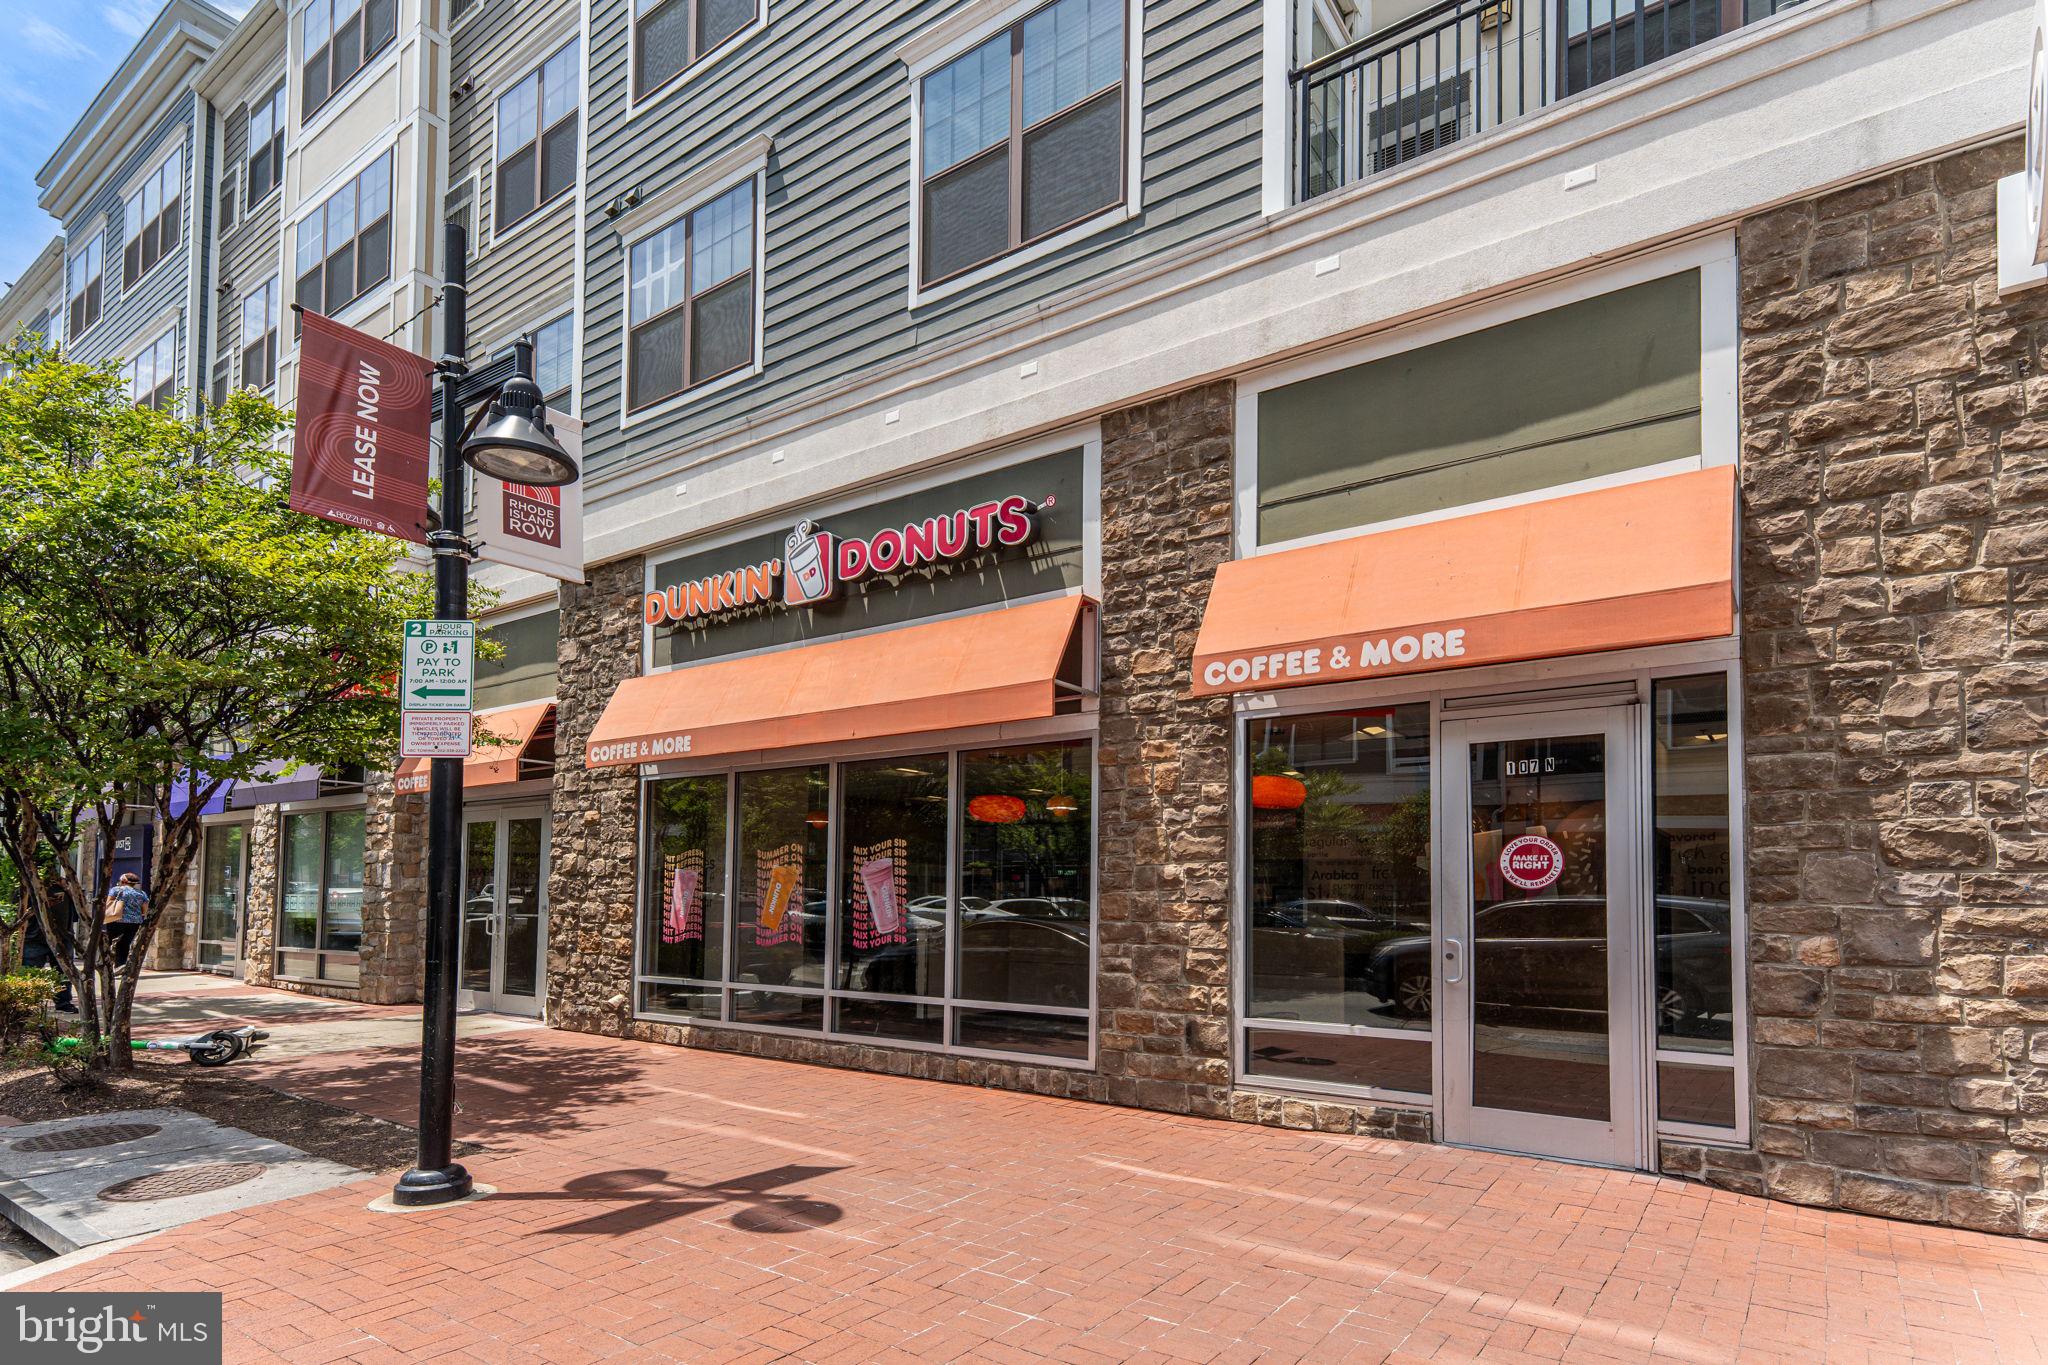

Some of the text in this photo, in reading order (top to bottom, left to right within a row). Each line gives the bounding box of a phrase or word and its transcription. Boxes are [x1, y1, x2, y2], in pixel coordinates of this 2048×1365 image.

[352, 360, 380, 500] LEASE NOW
[510, 498, 554, 519] RHODE
[336, 511, 372, 526] BOZZUTO
[510, 508, 554, 528] ISLAND
[510, 518, 554, 540] ROW
[645, 558, 782, 626] DUNKIN'
[838, 495, 1032, 581] DONUTS
[411, 623, 422, 636] 2
[416, 658, 460, 666] PAY TO
[1204, 629, 1466, 686] COFFEE & MORE
[422, 668, 454, 676] PARK
[590, 736, 692, 762] COFFEE & MORE
[1507, 758, 1554, 775] 107 N
[398, 775, 428, 791] COFFEE
[1669, 832, 1716, 842] avored
[756, 844, 802, 860] SUMMER ON
[853, 838, 907, 856] MIX YOUR SIP
[894, 848, 907, 857] SIP
[1504, 842, 1518, 856] LOVE
[1540, 840, 1558, 856] ORDER
[664, 849, 704, 862] HIT REFRESH
[756, 854, 802, 869] SUMMER ON
[664, 862, 676, 871] HIT
[894, 857, 907, 867] SIP
[1512, 862, 1550, 870] RIGHT
[664, 870, 675, 880] HIT
[894, 867, 907, 876] SIP
[1312, 870, 1358, 880] Arabica
[1688, 865, 1724, 874] bean
[664, 878, 674, 888] HIT
[894, 876, 907, 886] SIP
[1530, 872, 1556, 886] REMAKE
[853, 892, 868, 901] MIX
[853, 902, 868, 911] MIX
[853, 910, 868, 920] MIX
[790, 922, 802, 934] ON
[853, 920, 868, 930] MIX
[663, 928, 674, 937] HIT
[663, 932, 702, 944] HIT REFRESH
[790, 932, 802, 944] ON
[853, 930, 868, 940] MIX
[853, 939, 868, 949] MIX
[870, 935, 892, 948] YOUR
